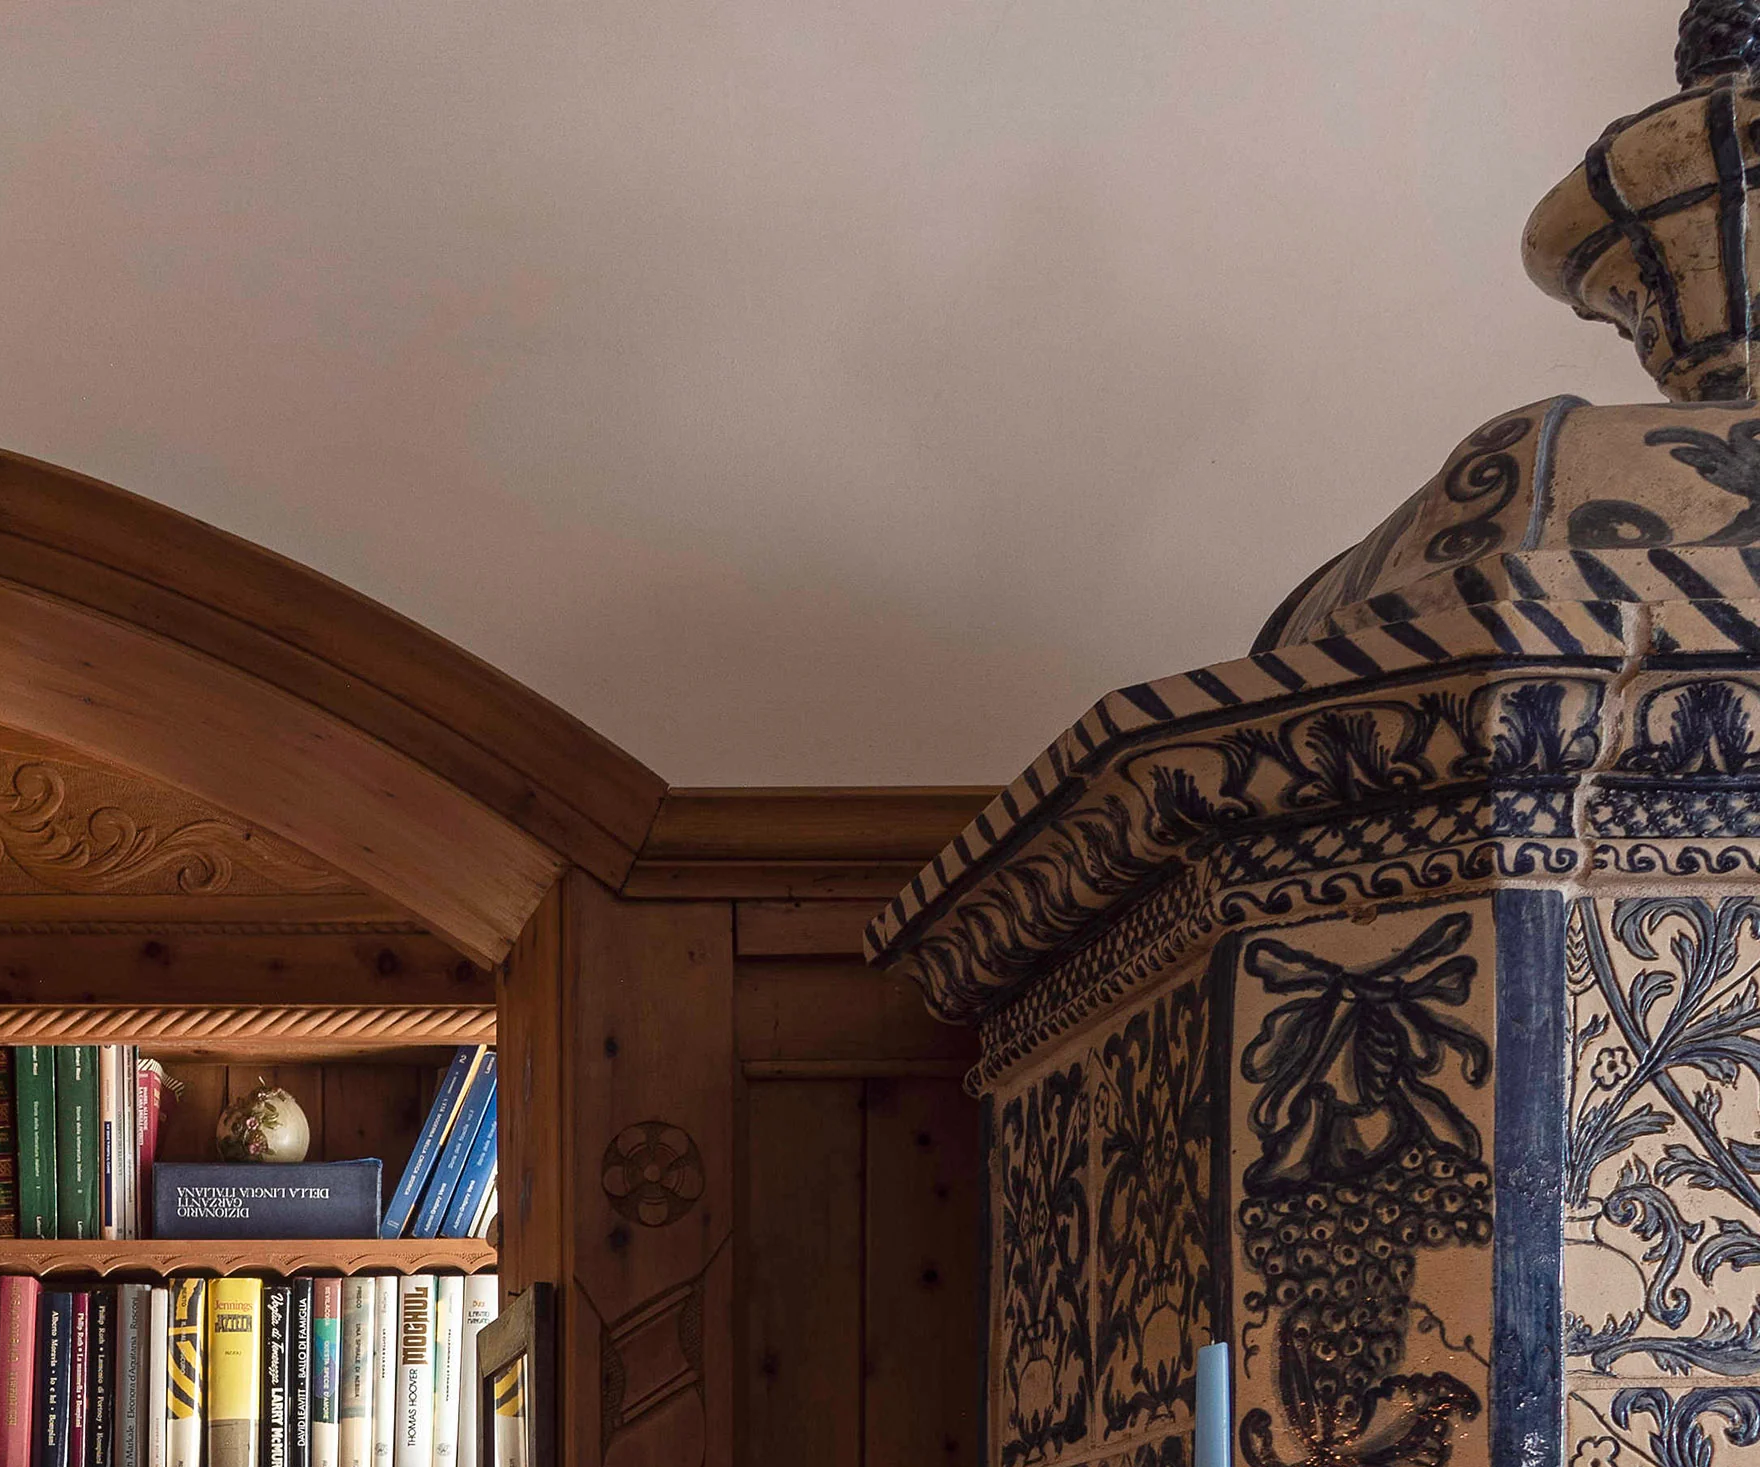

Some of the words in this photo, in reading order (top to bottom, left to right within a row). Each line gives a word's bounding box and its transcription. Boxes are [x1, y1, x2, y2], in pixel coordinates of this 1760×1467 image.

[177, 1186, 236, 1198] ITALIANA
[177, 1197, 243, 1208] GARZANTI
[238, 1187, 285, 1199] LINGUA
[286, 1187, 330, 1199] DELLA
[177, 1207, 250, 1219] DIZIONARIO
[129, 1297, 139, 1329] Rusconi
[214, 1300, 252, 1311] Jennings
[269, 1293, 284, 1326] Voglia
[298, 1298, 307, 1338] FAMIGLIA
[272, 1328, 280, 1339] di
[402, 1287, 430, 1365] MOGHUL
[128, 1336, 139, 1381] d'Aquitania
[298, 1340, 307, 1349] DI
[269, 1341, 285, 1385] Tenerezza
[298, 1352, 307, 1378] BALLO
[126, 1382, 136, 1419] Eleonora
[408, 1369, 418, 1406] HOOVER
[271, 1387, 283, 1425] LARRY
[298, 1388, 307, 1419] LEAVITT
[125, 1425, 135, 1459] Markale
[298, 1420, 307, 1446] DAVID
[408, 1409, 417, 1446] THOMAS
